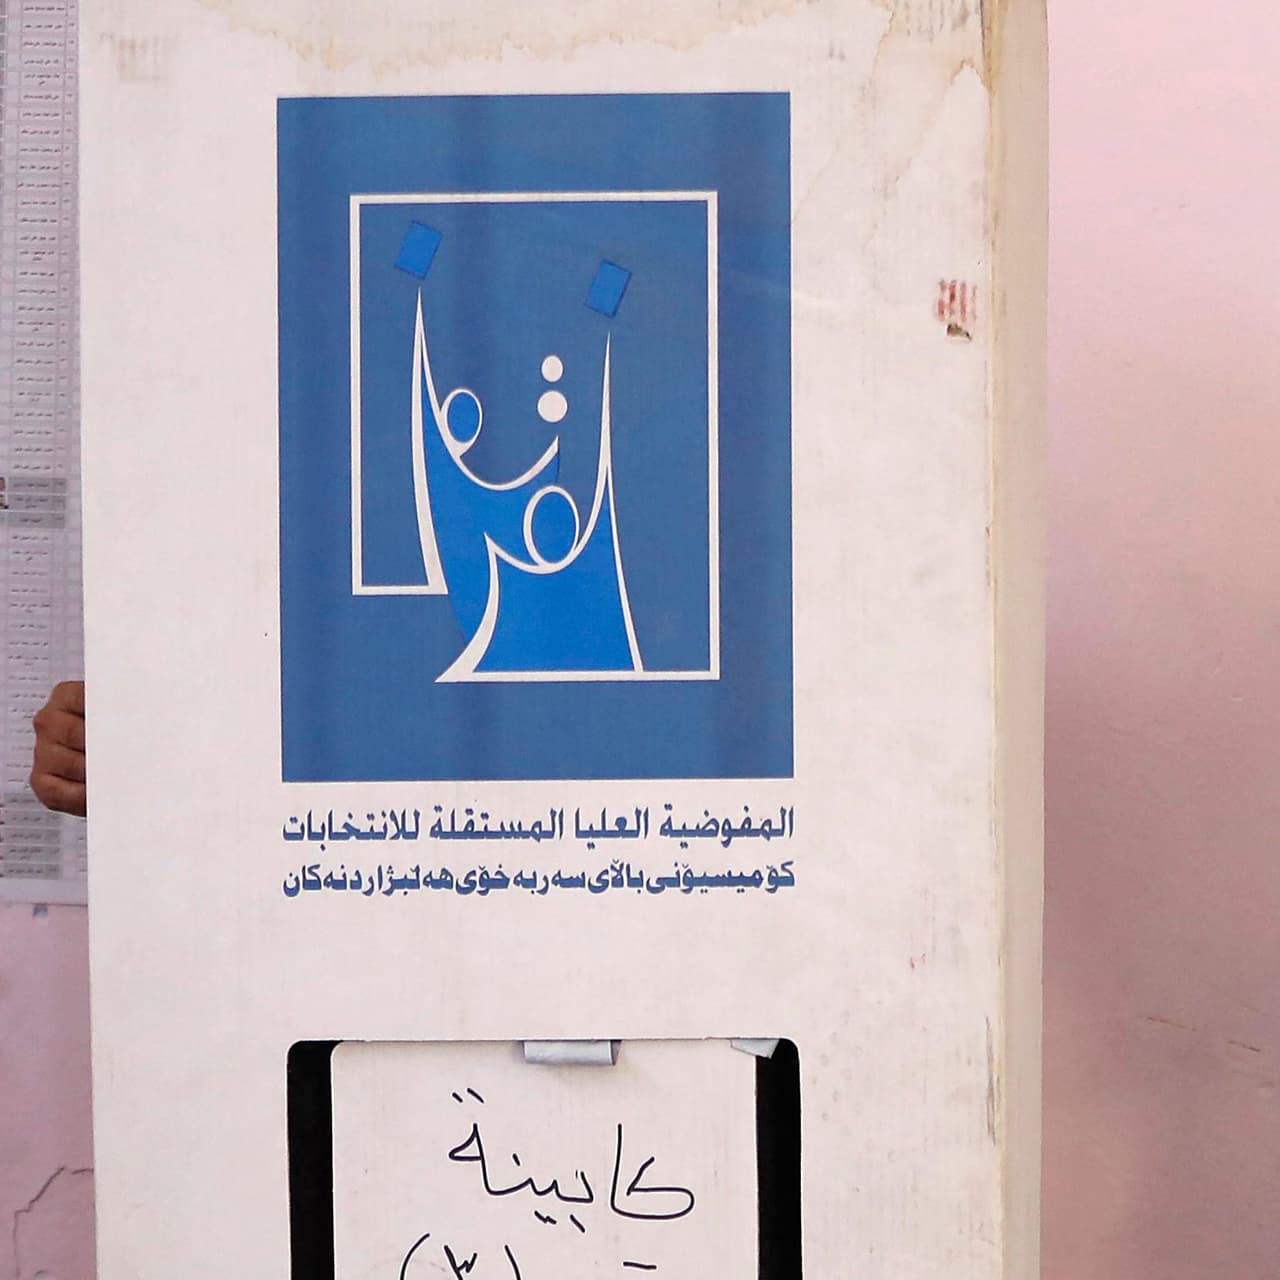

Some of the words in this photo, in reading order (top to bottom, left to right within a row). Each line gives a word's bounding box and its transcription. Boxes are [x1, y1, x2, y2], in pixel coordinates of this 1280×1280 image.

[281, 806, 421, 851] للانتخابات
[429, 804, 565, 842] المستقلة
[574, 806, 649, 850] العليا
[659, 804, 795, 849] المفوضية
[448, 1087, 696, 1233] كابينة
